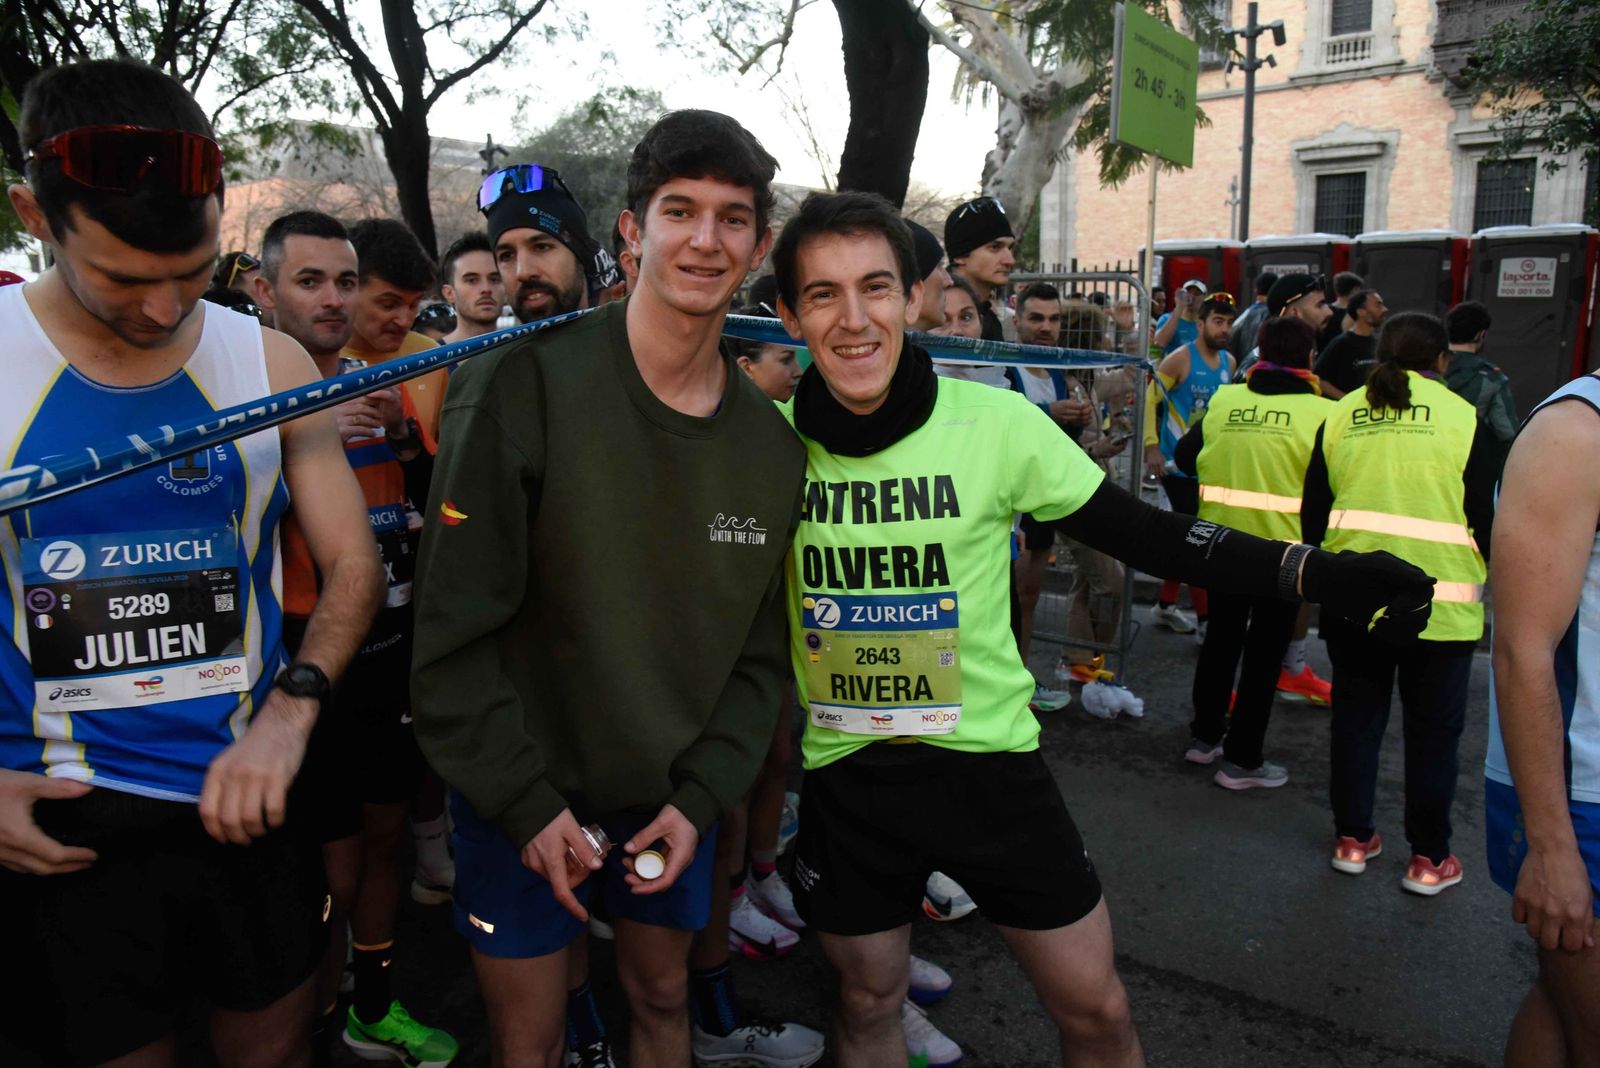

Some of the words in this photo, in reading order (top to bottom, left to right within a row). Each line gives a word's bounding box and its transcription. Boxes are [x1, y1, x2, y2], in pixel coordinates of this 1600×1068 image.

[156, 474, 224, 496] COLOMBES
[369, 510, 398, 526] RICH
[717, 530, 732, 542] WITH
[734, 531, 746, 544] THE
[748, 532, 766, 544] FLOW
[100, 539, 213, 567] ZURICH
[803, 543, 951, 589] OLVERA
[108, 592, 171, 620] 5289
[851, 604, 938, 623] ZURICH
[74, 622, 207, 670] JULIEN
[855, 647, 901, 665] 2643
[63, 687, 91, 698] asics
[830, 673, 934, 702] RIVERA
[825, 713, 843, 722] asics
